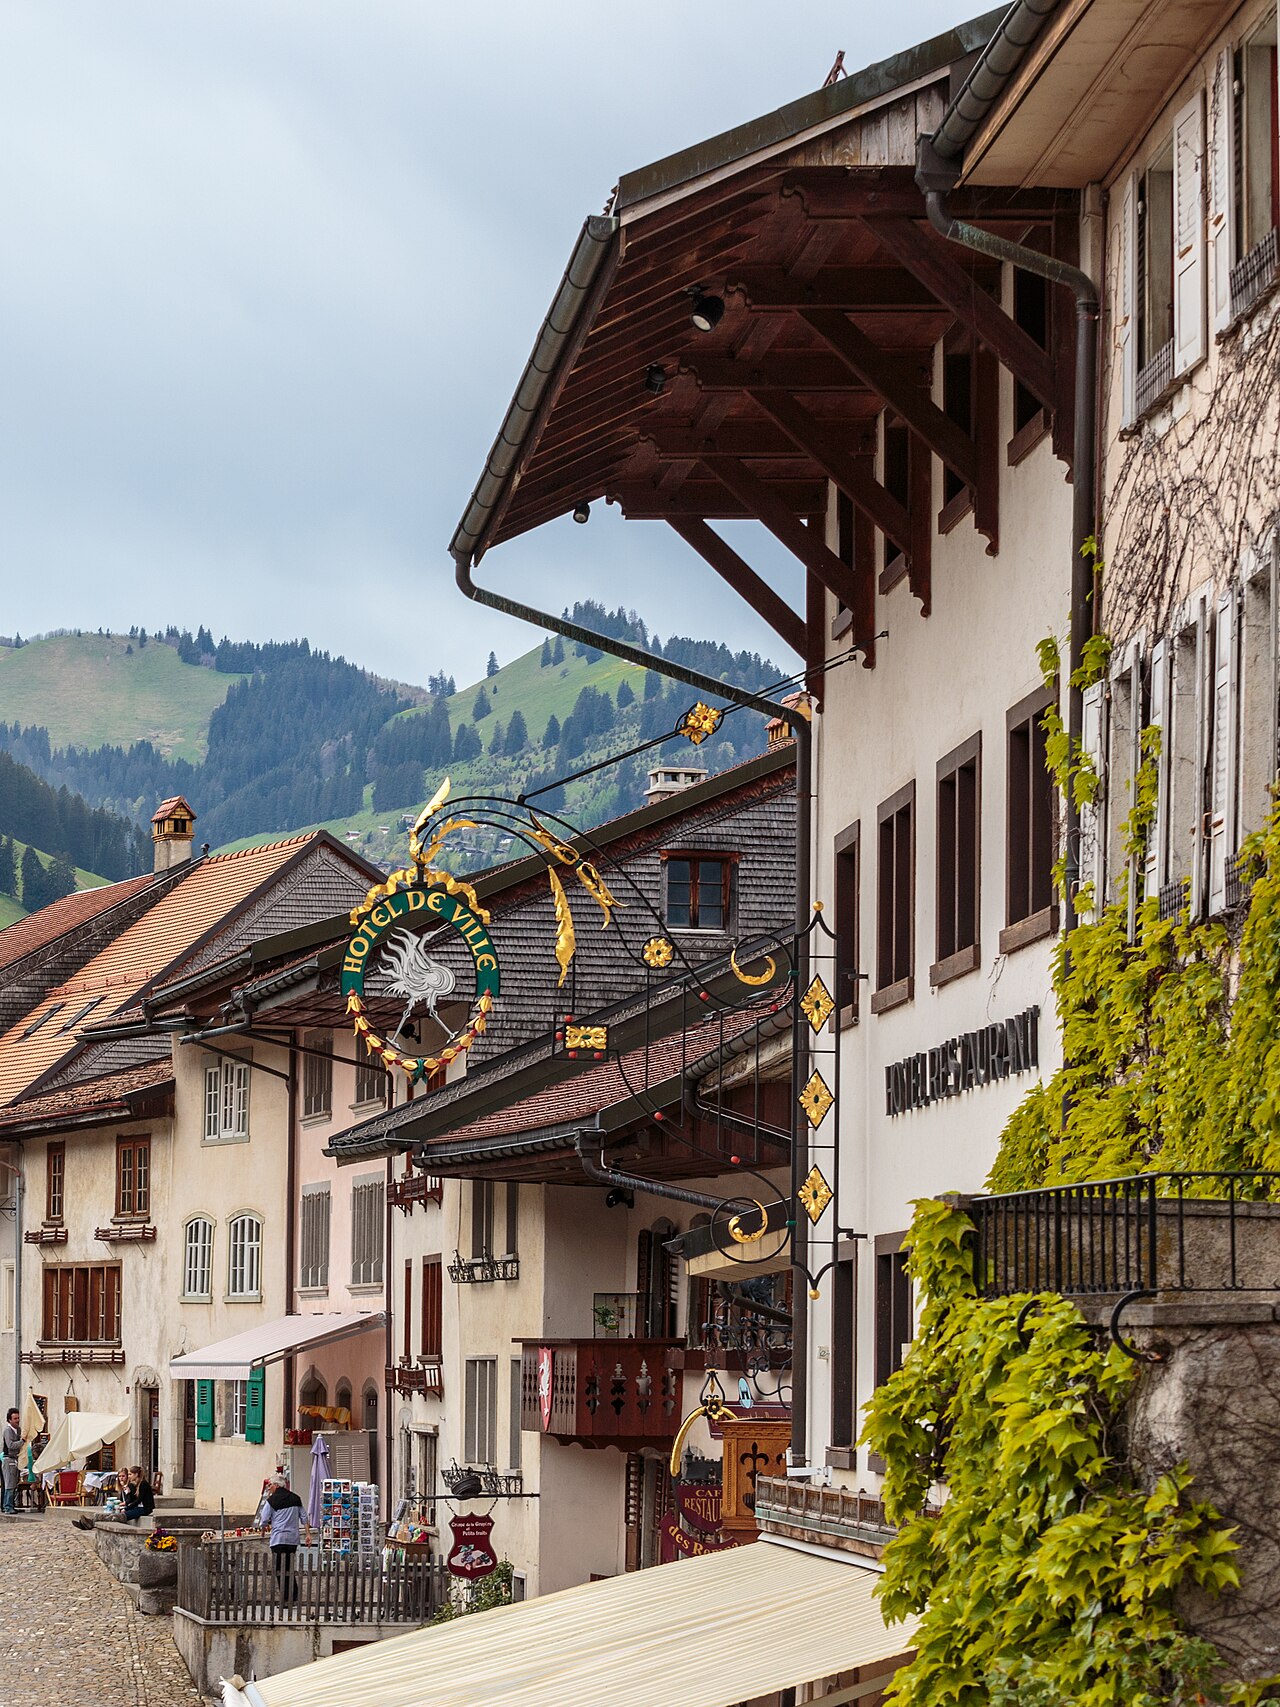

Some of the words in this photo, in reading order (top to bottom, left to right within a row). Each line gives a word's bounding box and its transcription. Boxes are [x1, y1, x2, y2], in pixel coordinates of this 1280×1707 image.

[343, 900, 402, 973] HOTEL
[406, 891, 447, 913] DE
[451, 904, 498, 972] VILLE
[885, 1052, 930, 1119] HOTEL
[928, 1004, 1041, 1104] RESTAURANT
[668, 1525, 690, 1549] des
